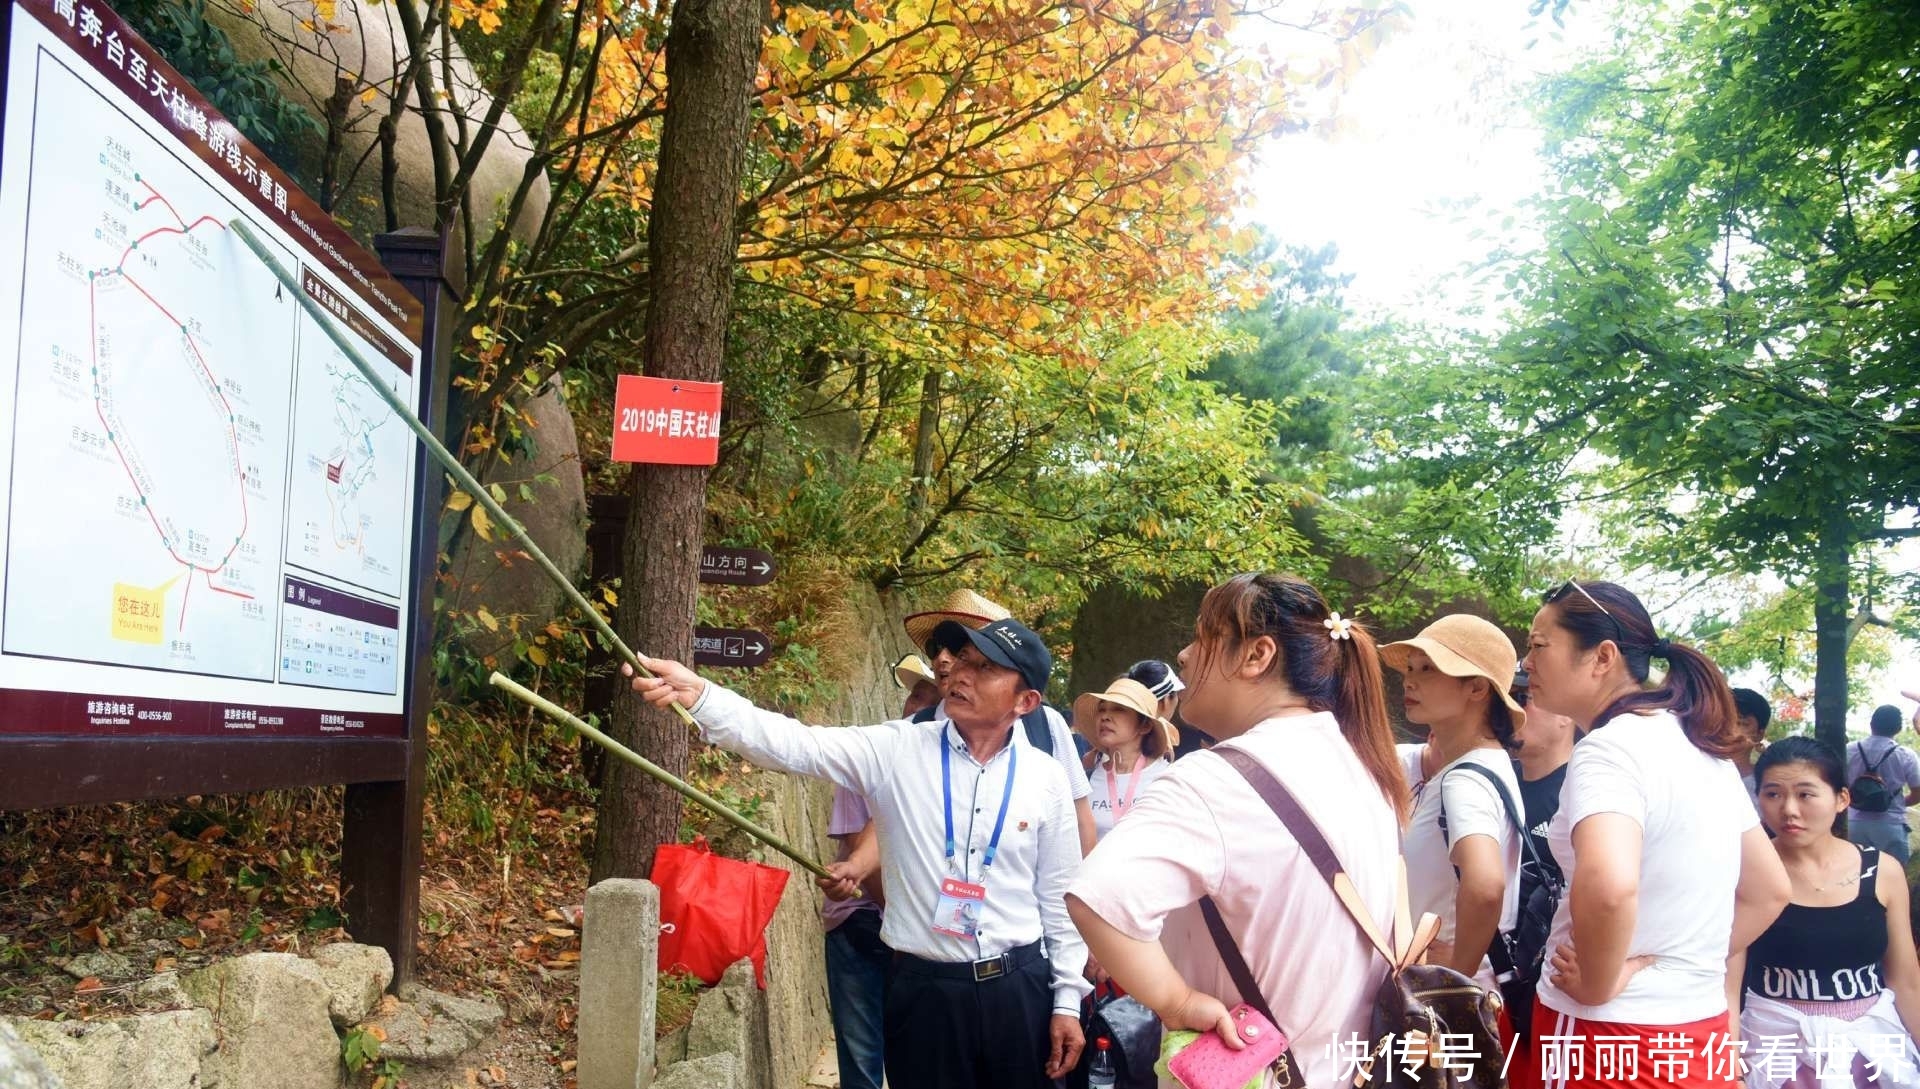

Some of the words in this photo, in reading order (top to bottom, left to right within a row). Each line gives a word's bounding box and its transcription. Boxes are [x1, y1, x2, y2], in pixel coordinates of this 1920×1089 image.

[290, 210, 310, 235] Sketch
[311, 229, 323, 247] Map
[703, 553, 747, 569] 山方向
[117, 596, 161, 619] 您在这儿
[118, 618, 131, 630] You
[87, 701, 135, 716] 旅游咨询电话
[1762, 963, 1882, 1000] UNLOCK
